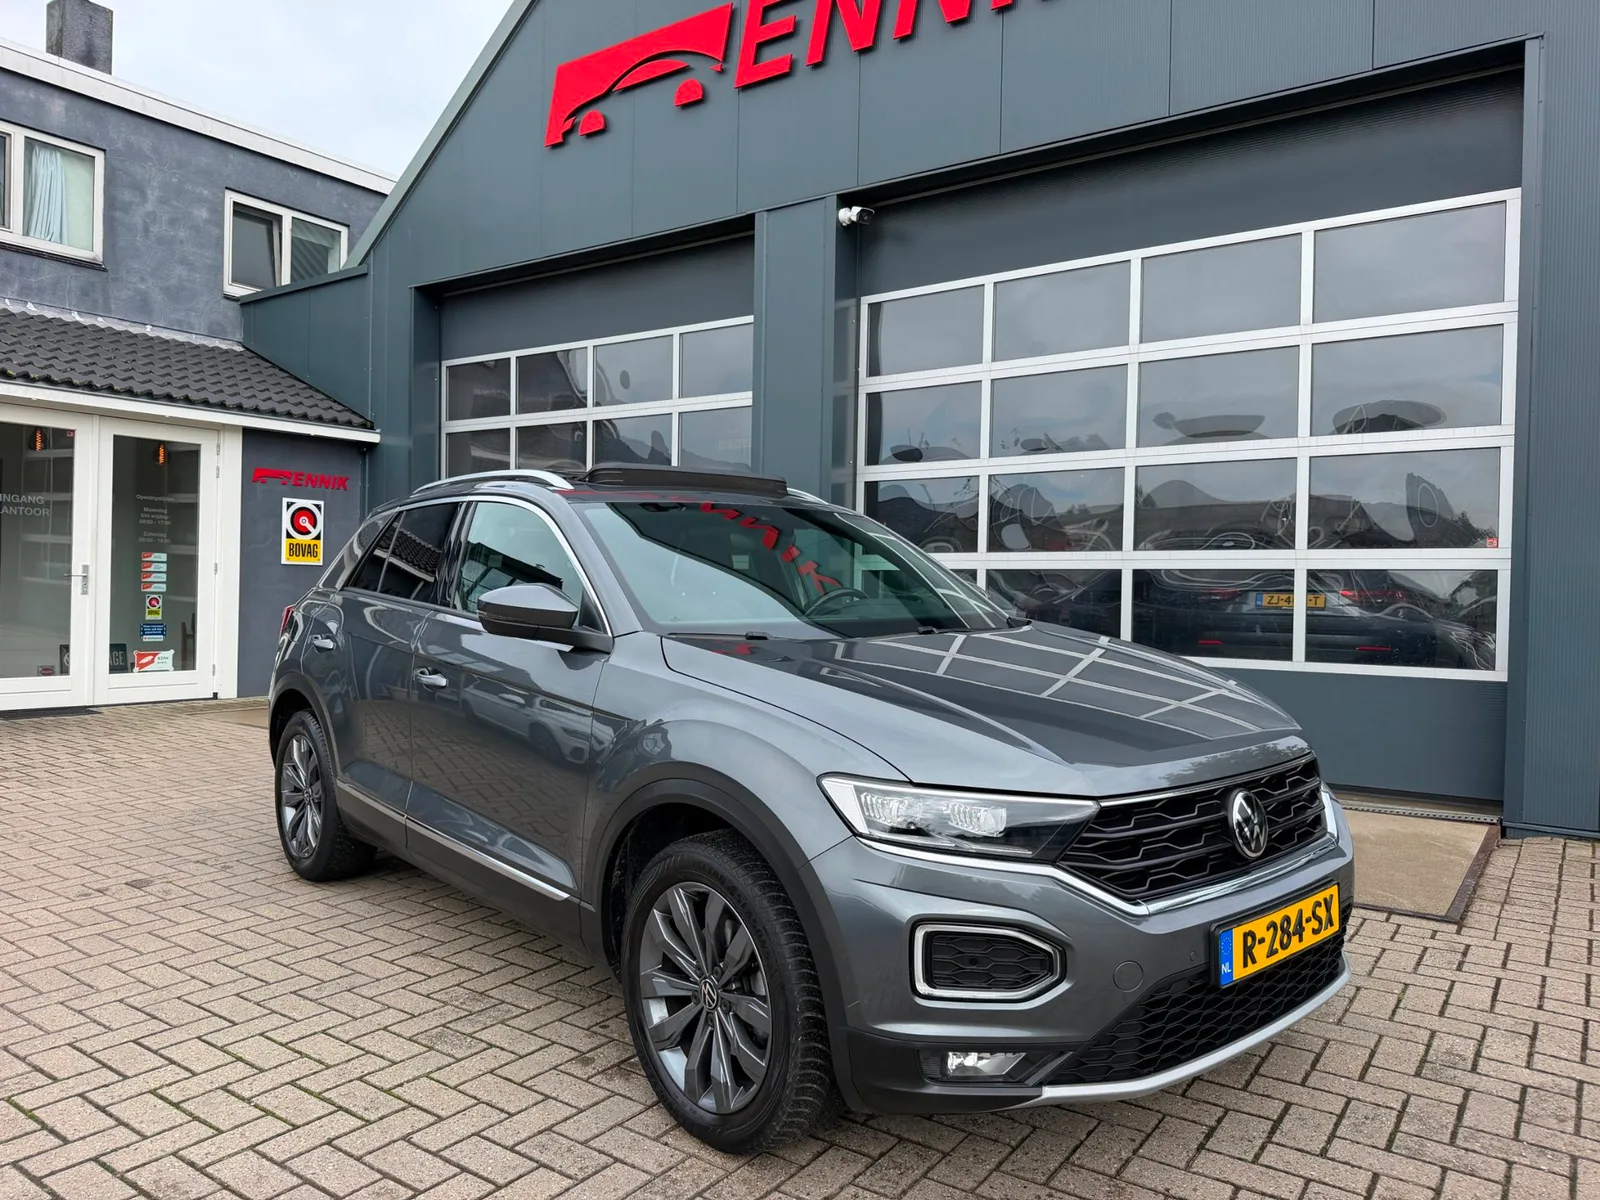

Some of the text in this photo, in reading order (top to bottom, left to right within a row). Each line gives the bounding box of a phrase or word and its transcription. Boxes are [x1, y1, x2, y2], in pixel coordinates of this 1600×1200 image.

[291, 471, 350, 491] ENNIK
[0, 505, 50, 517] ANTOOR
[288, 543, 318, 558] BOVAG
[1266, 595, 1320, 606] ZJ-4-T
[1242, 893, 1335, 968] R-284-SX
[1221, 962, 1232, 974] NL
